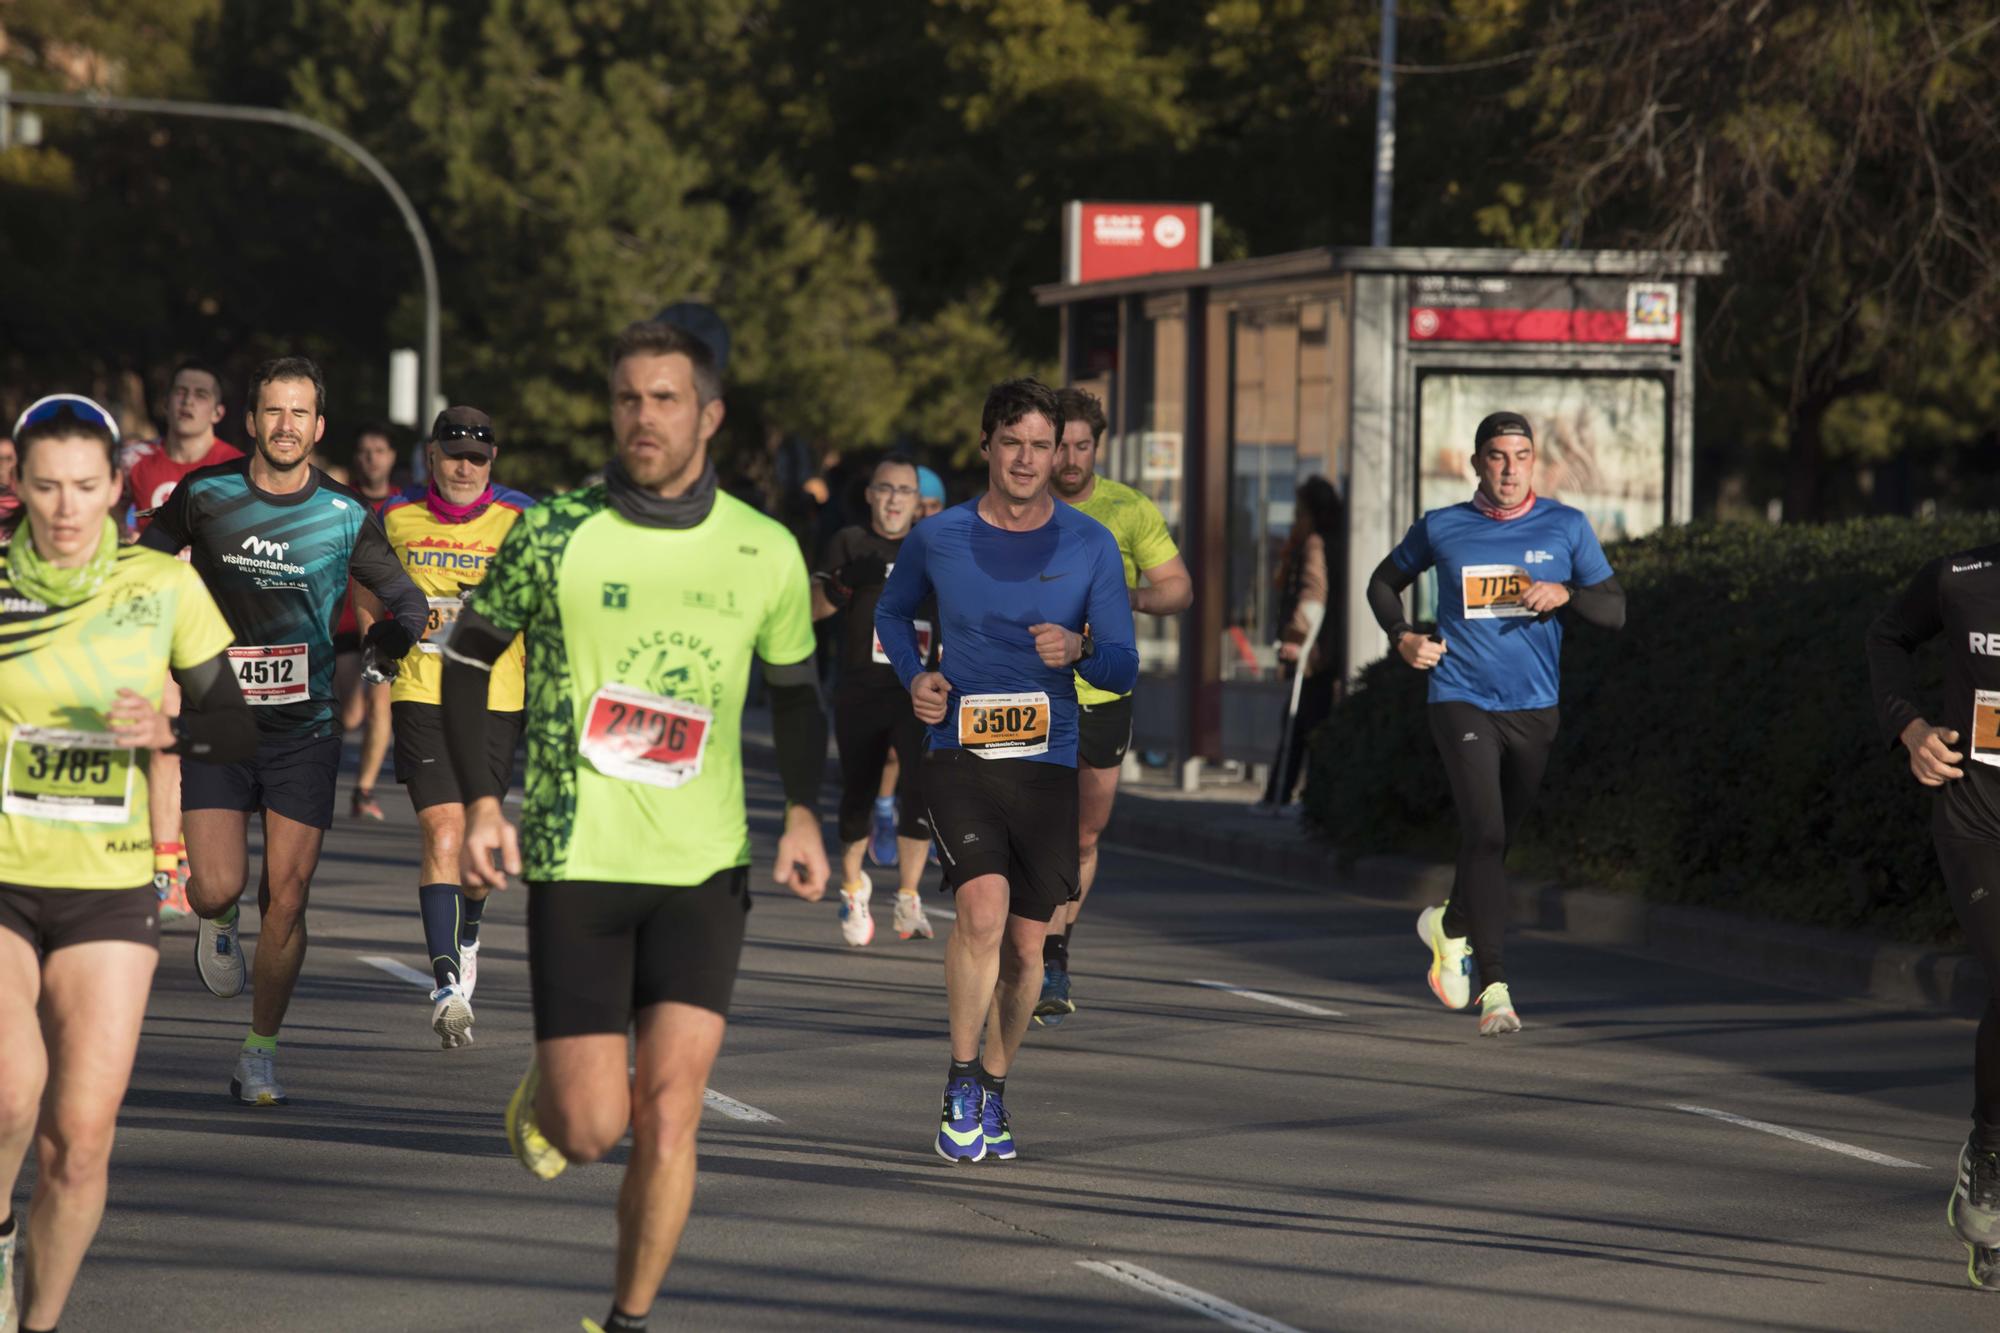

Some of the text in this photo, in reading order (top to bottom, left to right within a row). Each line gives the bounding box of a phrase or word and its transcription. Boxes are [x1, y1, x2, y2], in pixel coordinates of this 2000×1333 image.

[222, 553, 306, 575] visitmontanejos
[238, 565, 257, 574] VILLA
[1478, 574, 1521, 597] 7775
[238, 659, 294, 684] 4512
[973, 706, 1037, 734] 3502
[28, 744, 111, 784] 3785
